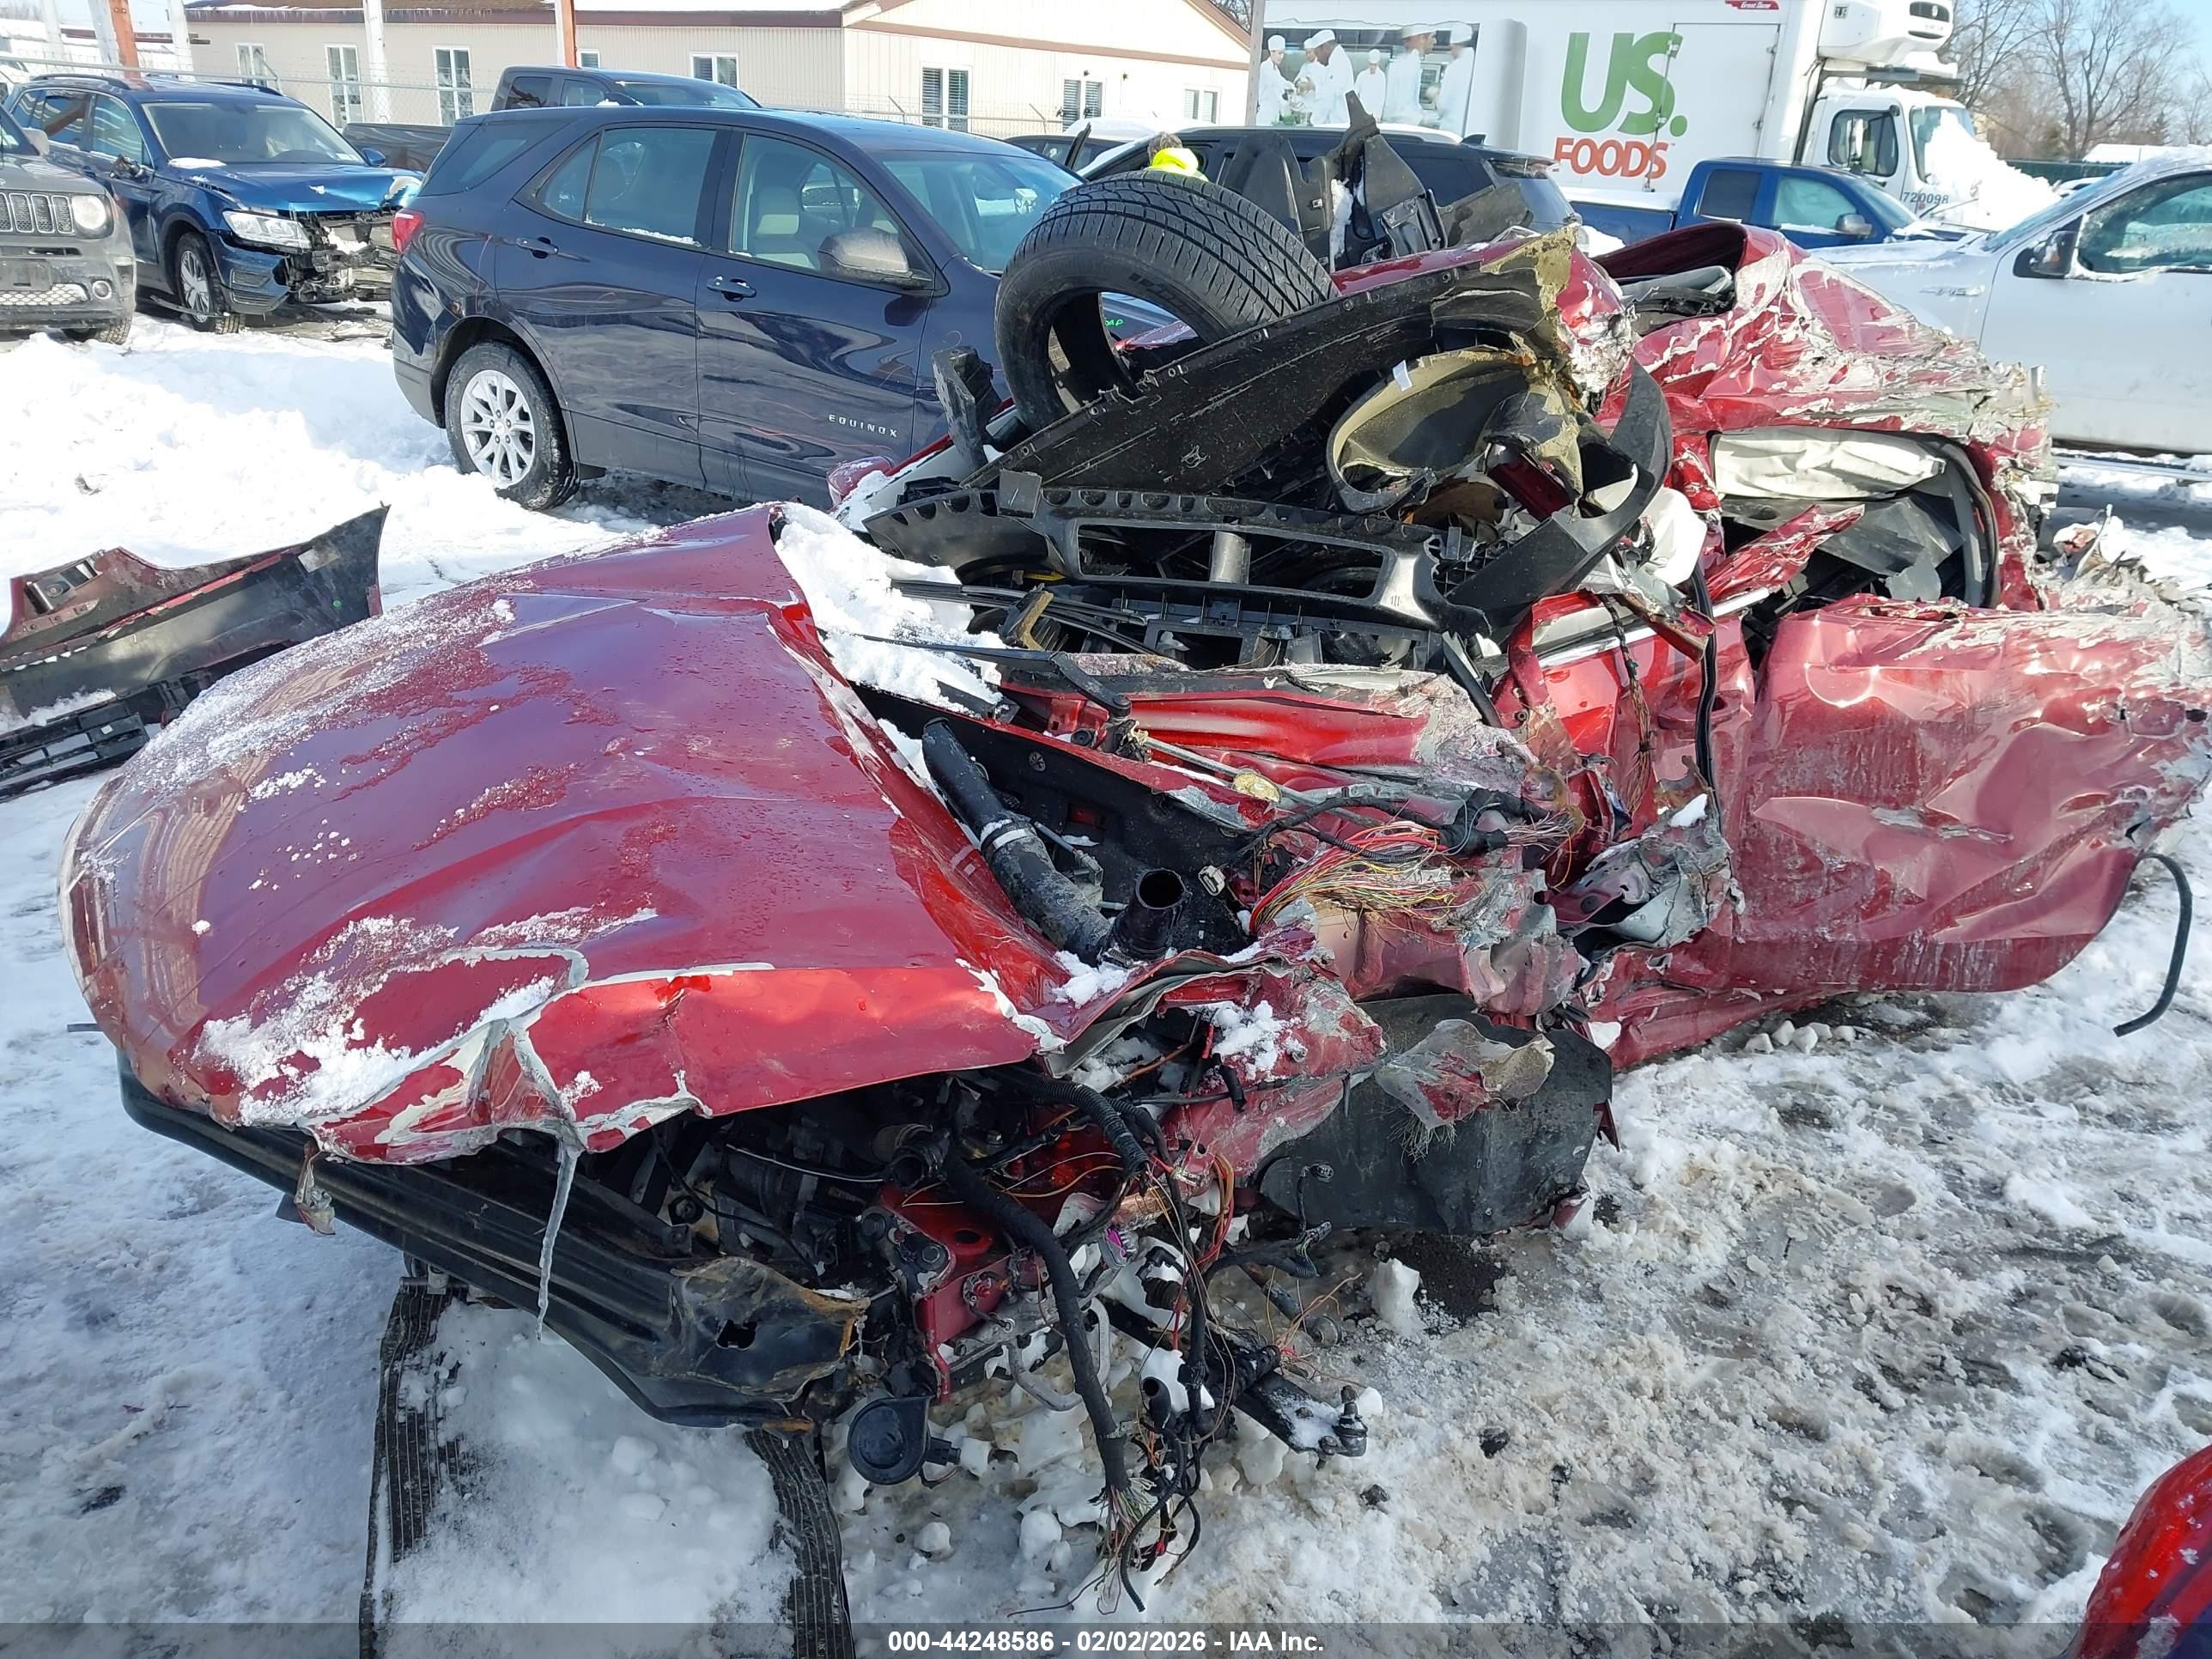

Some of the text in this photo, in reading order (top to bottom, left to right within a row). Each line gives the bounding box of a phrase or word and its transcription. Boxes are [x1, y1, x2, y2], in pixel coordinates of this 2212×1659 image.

[1561, 31, 1688, 137] US.
[1553, 137, 1669, 179] FOODS
[829, 414, 897, 437] EQUINOX
